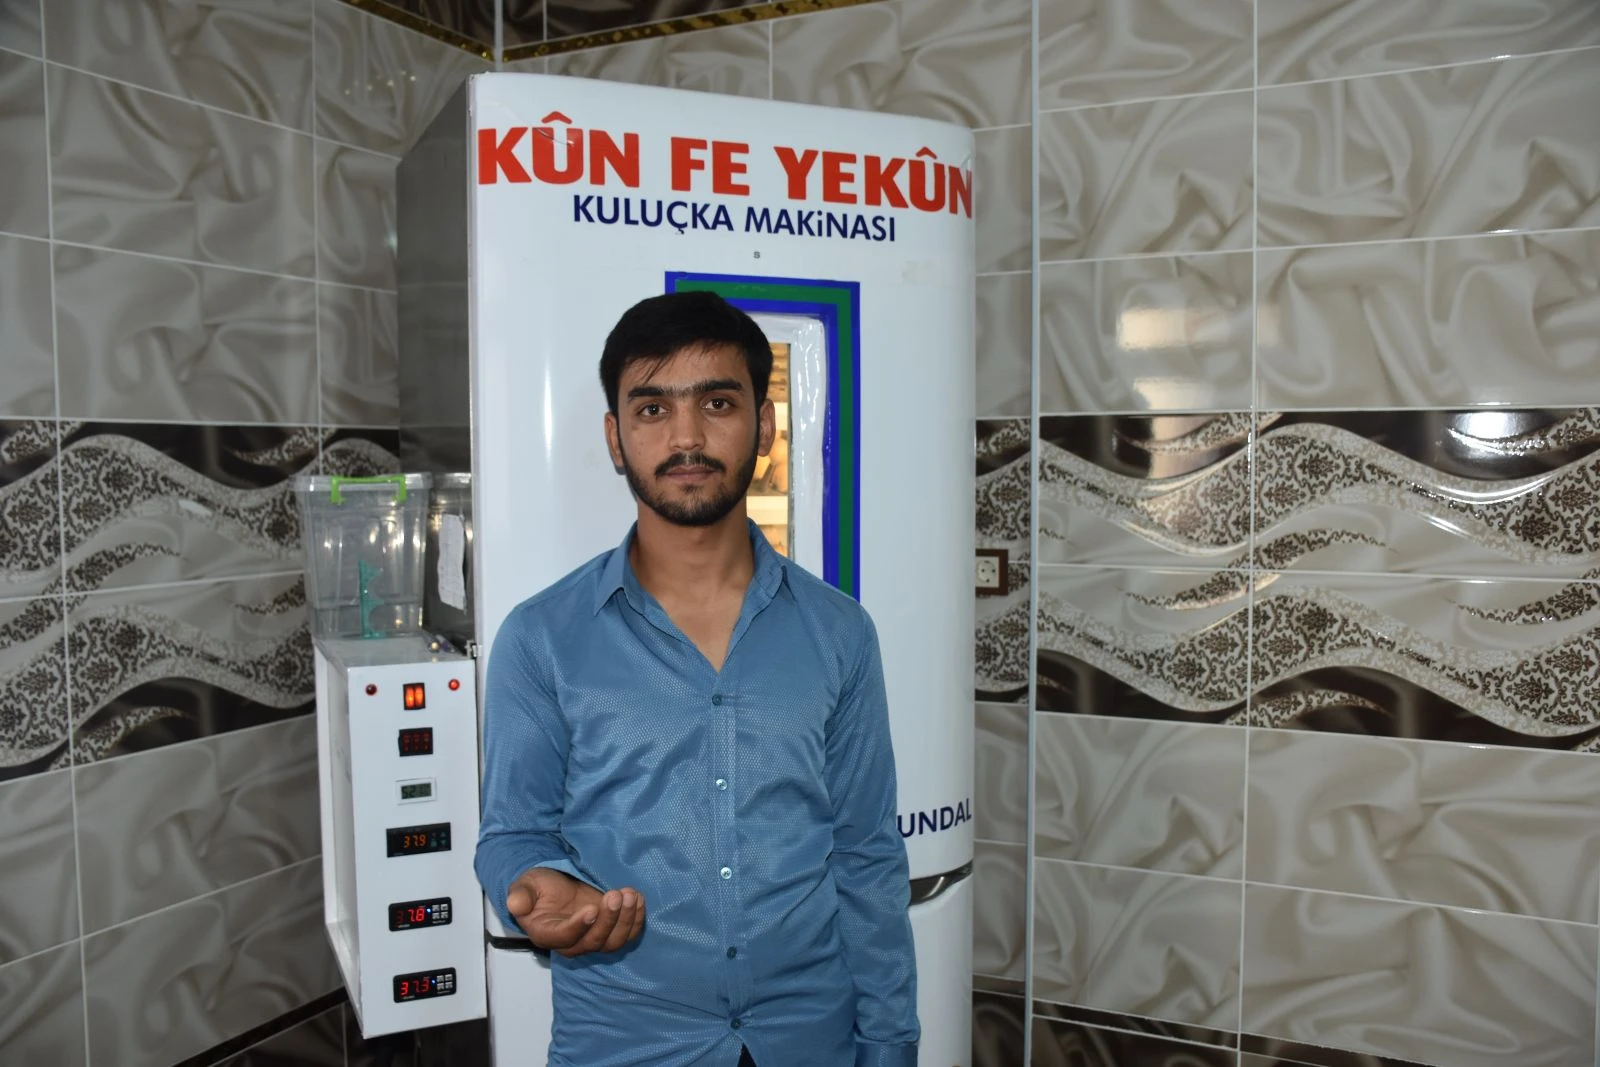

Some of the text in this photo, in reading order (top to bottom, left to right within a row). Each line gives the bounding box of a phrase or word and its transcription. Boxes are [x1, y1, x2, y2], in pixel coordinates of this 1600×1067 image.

[478, 111, 972, 219] KÛN FE YEKÛN
[573, 195, 734, 235] KULUÇKA
